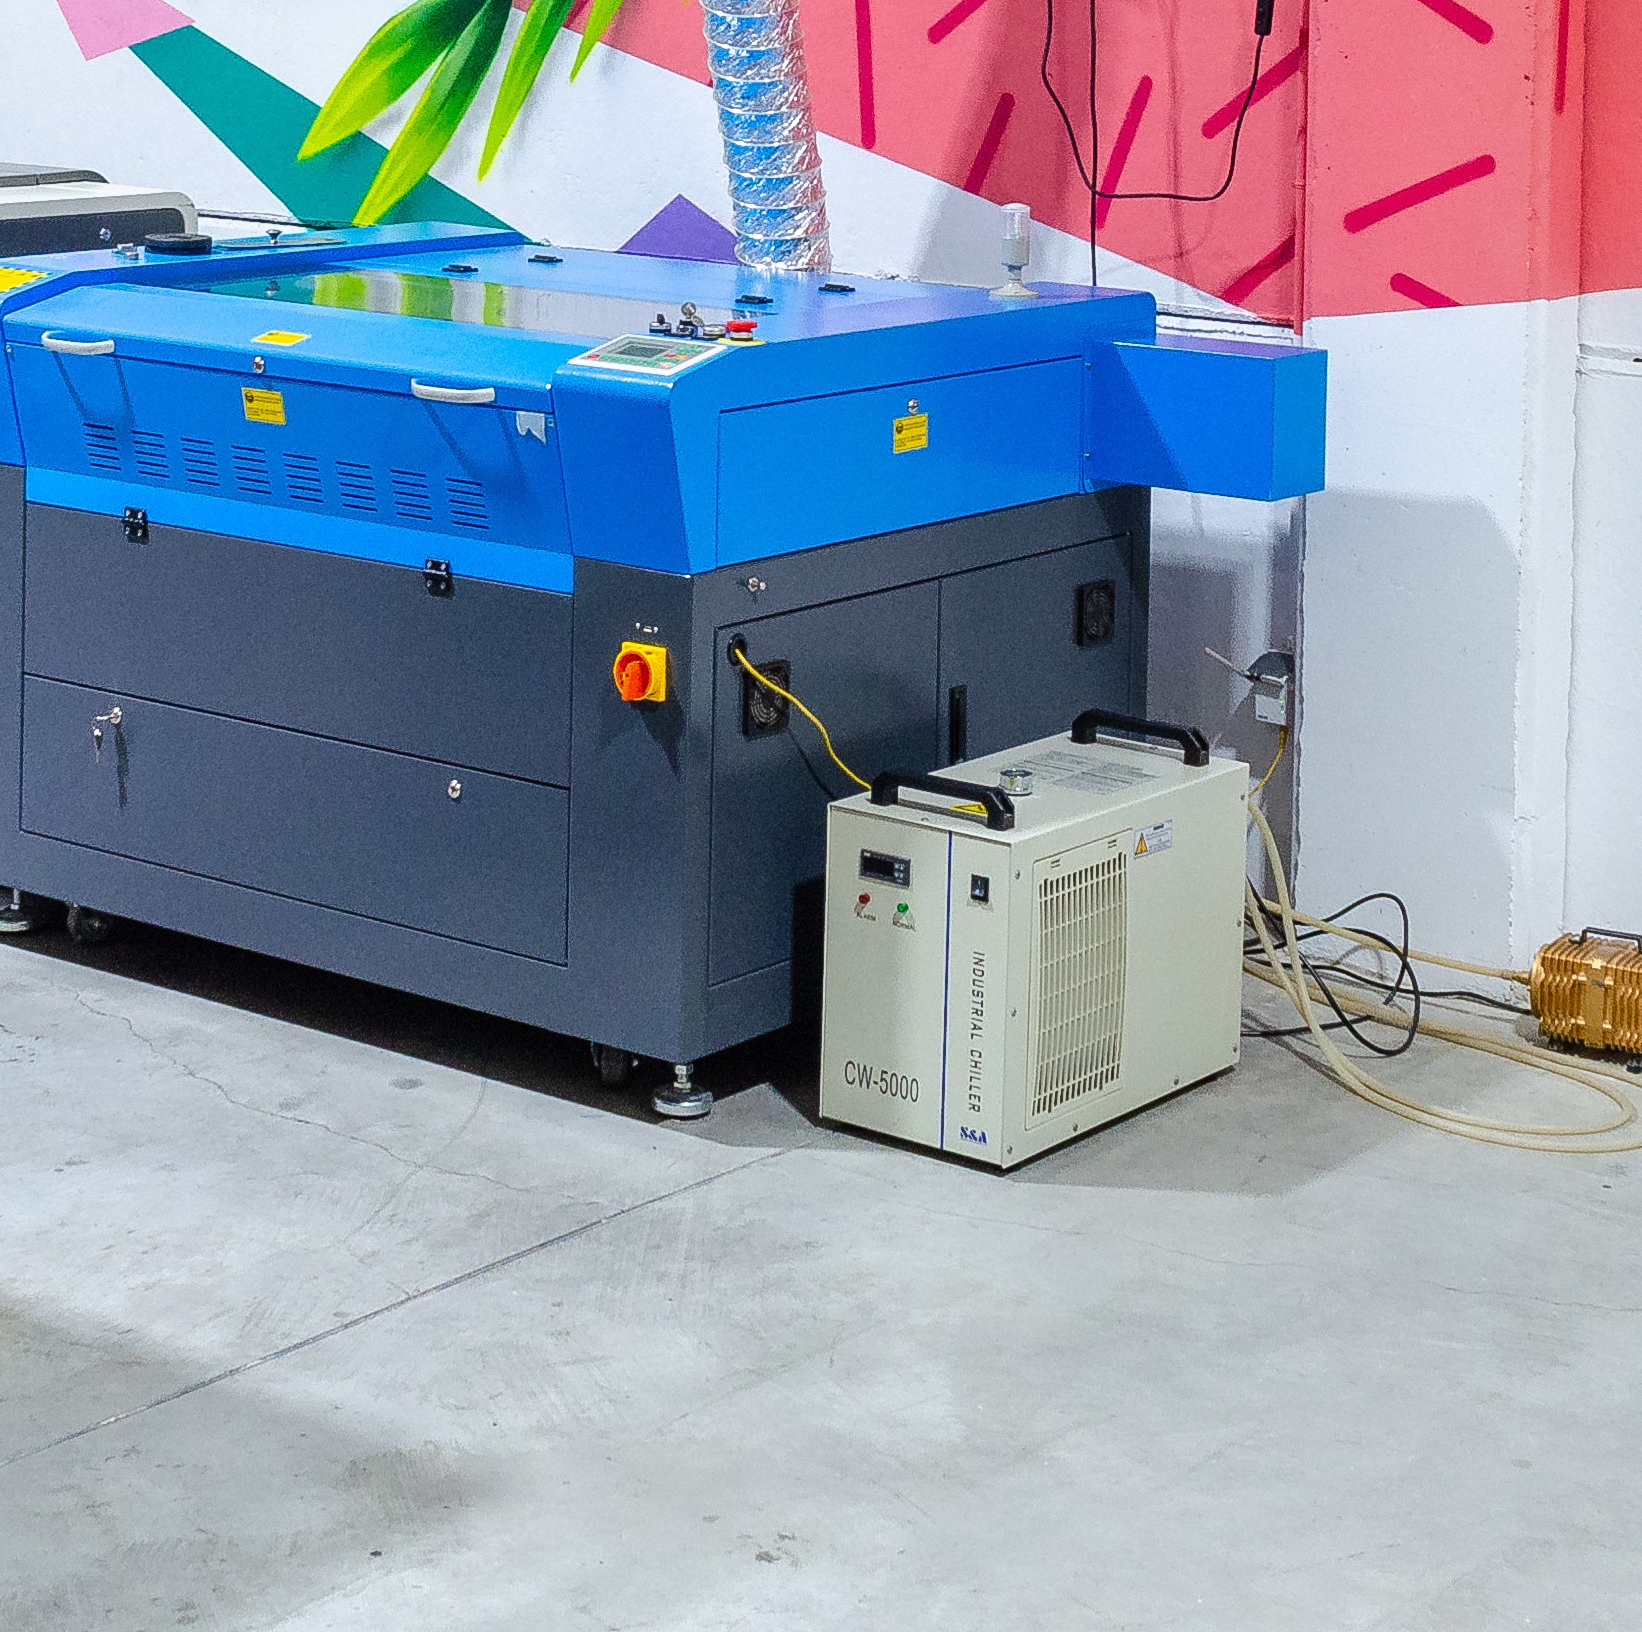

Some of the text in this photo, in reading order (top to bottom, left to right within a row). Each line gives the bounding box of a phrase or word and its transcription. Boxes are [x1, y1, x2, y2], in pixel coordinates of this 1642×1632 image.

[844, 1060, 919, 1102] CW-5000
[968, 951, 985, 1113] INDUSTRIAL CHILLER
